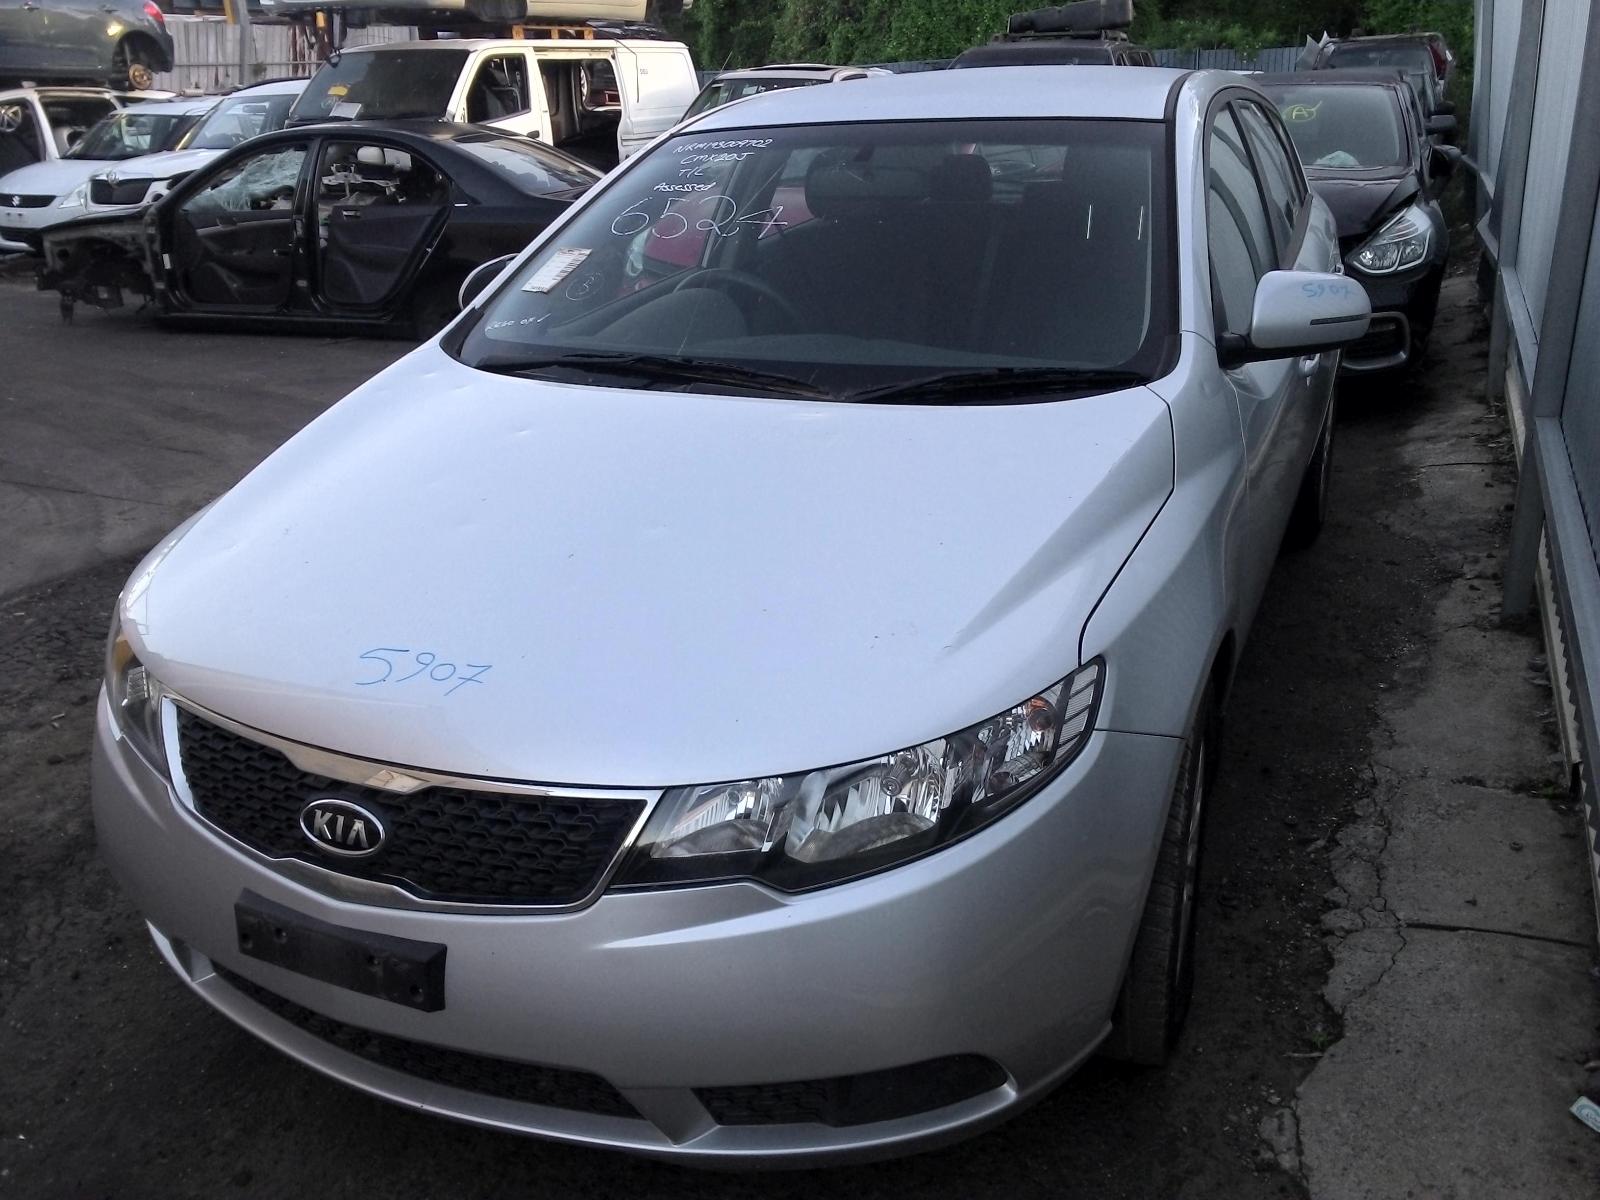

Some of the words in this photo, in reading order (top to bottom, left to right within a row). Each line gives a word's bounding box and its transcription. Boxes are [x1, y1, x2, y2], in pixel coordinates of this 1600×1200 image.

[654, 182, 717, 192] Assessed
[355, 648, 493, 696] 5907
[313, 808, 370, 849] KIA
